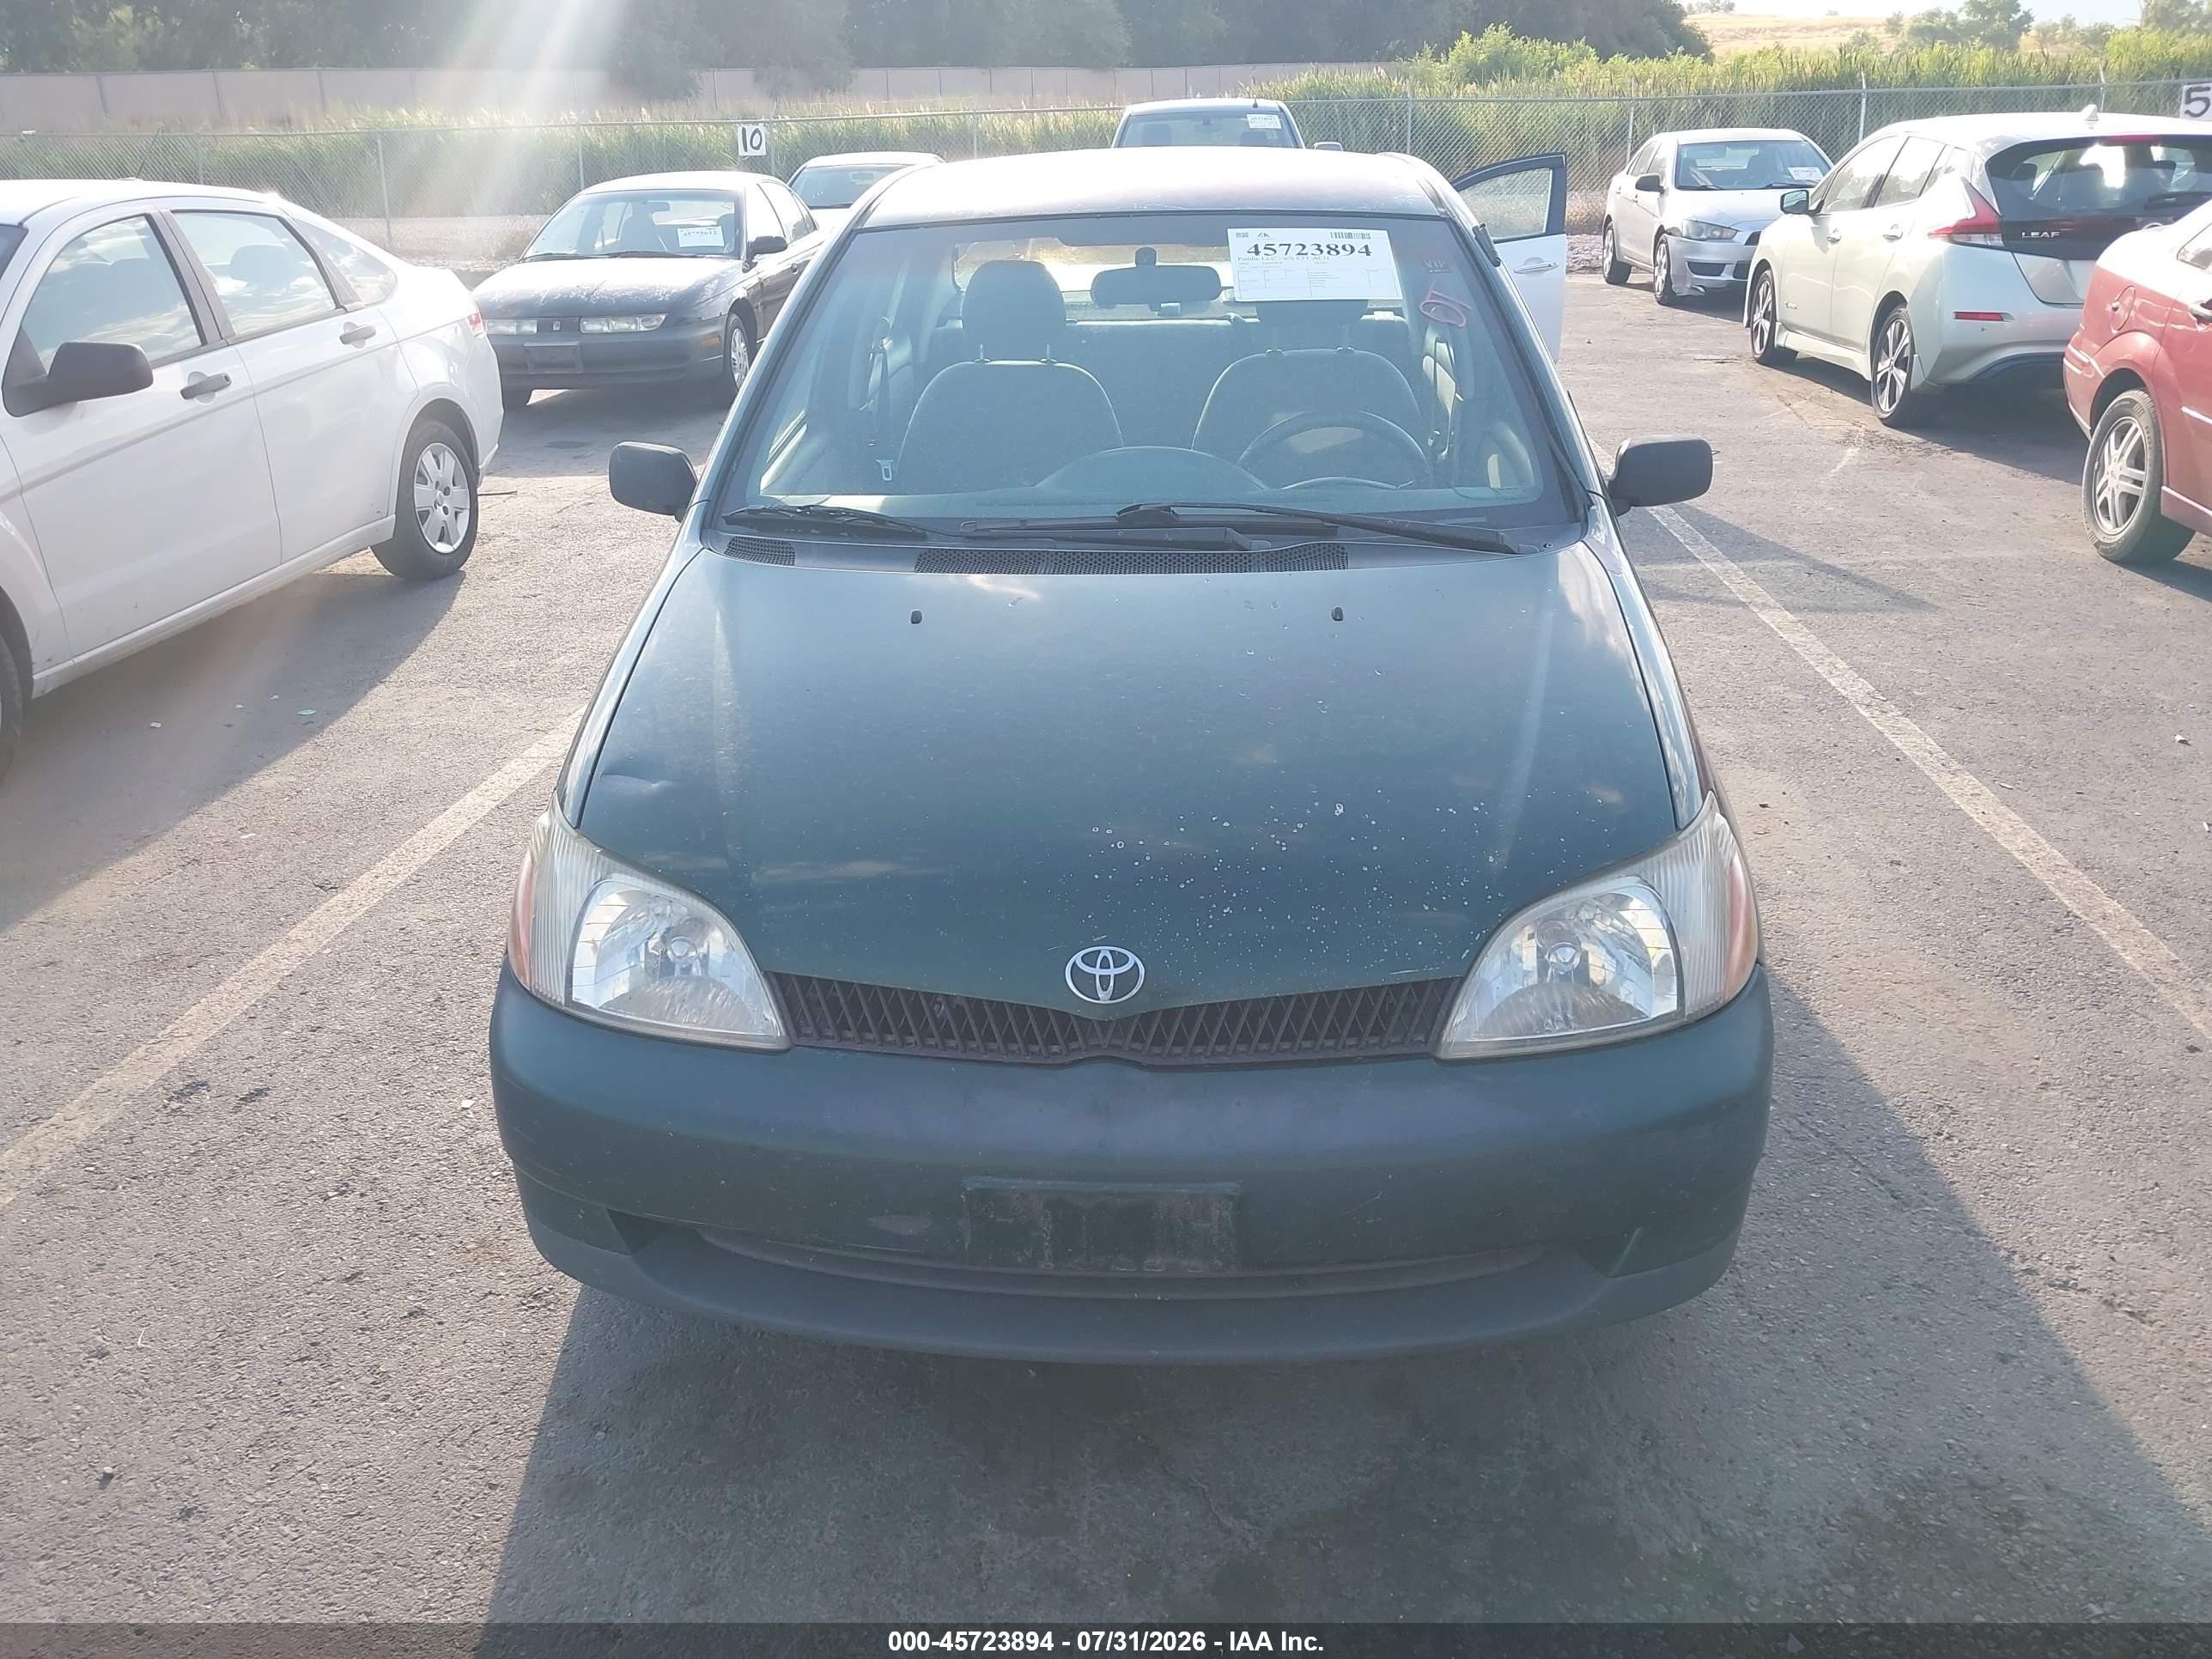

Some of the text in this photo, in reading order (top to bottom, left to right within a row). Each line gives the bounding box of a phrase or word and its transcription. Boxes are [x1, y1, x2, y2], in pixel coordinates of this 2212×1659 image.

[2184, 86, 2211, 118] 5
[741, 126, 763, 153] 10
[1246, 243, 1372, 257] 45723894
